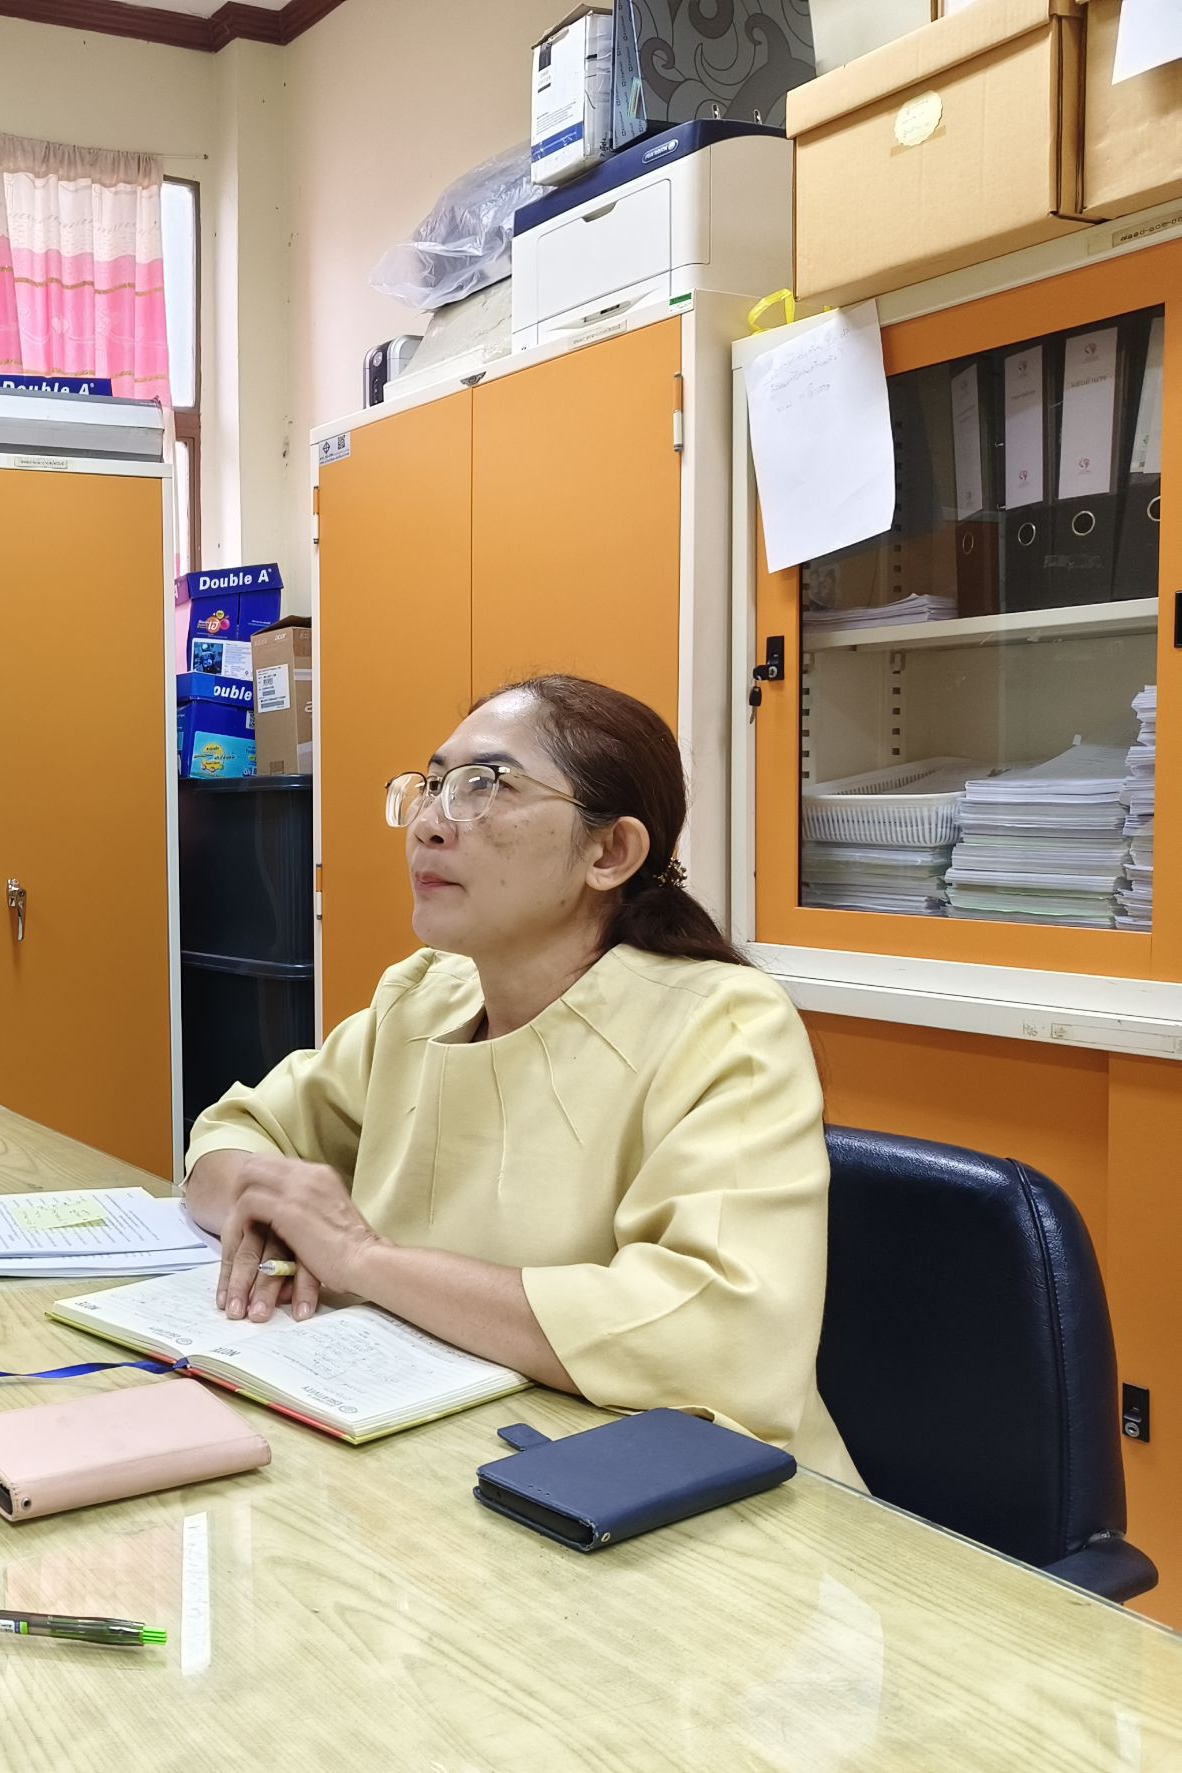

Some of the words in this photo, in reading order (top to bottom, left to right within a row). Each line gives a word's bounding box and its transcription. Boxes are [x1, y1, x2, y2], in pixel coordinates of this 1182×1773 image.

[199, 572, 253, 590] Double
[258, 569, 269, 584] A
[213, 684, 253, 701] ouble
